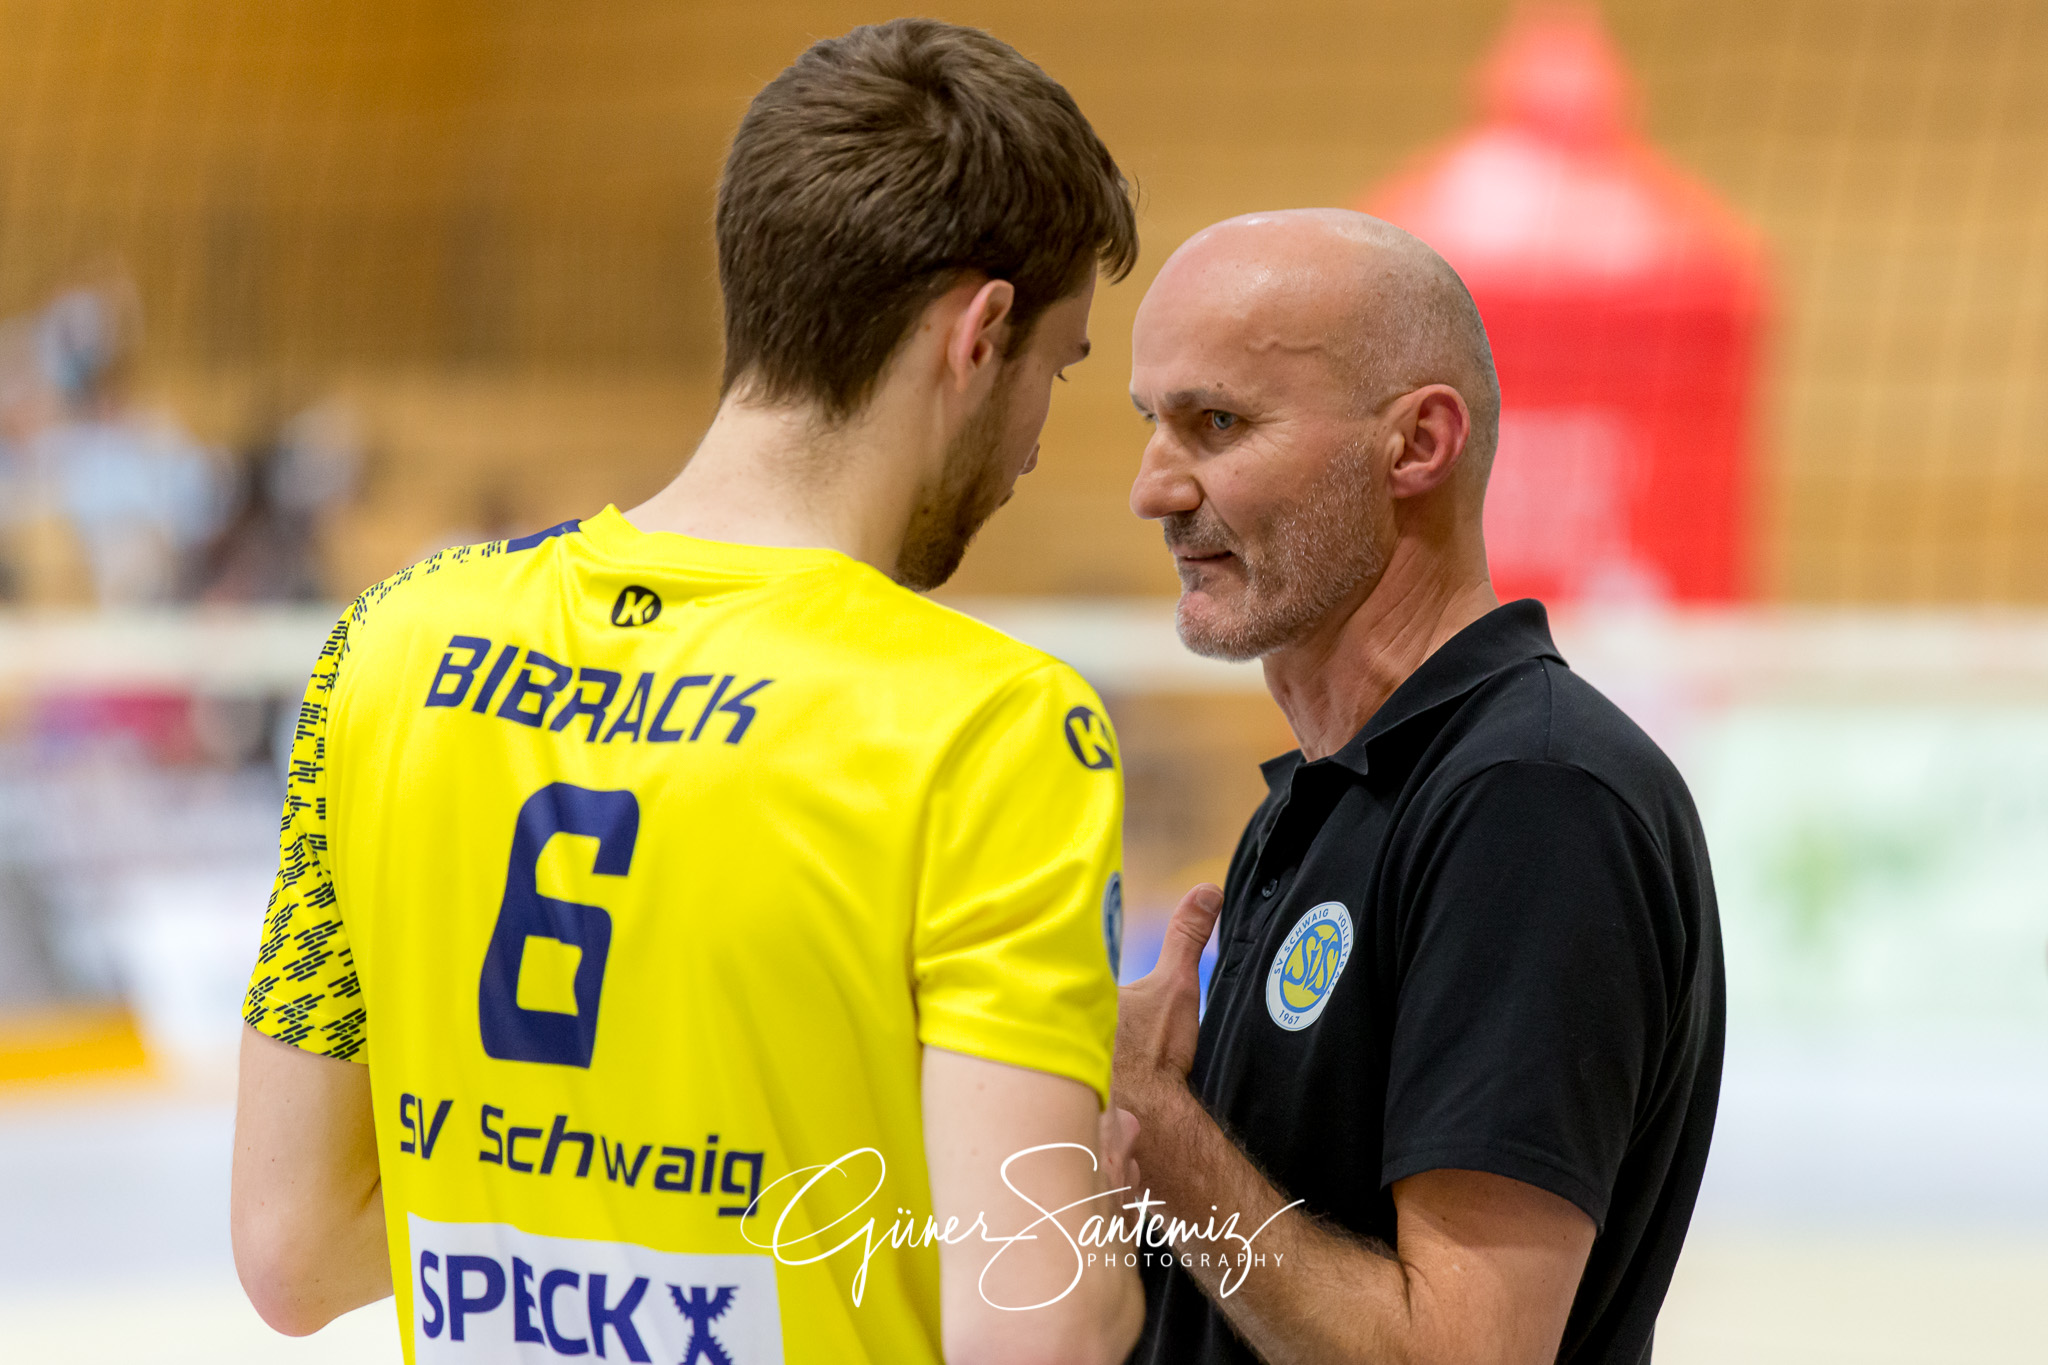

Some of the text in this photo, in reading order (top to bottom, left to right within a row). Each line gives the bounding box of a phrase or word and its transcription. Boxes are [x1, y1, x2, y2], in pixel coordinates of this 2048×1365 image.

[424, 635, 776, 745] BIBRACK
[479, 781, 641, 1069] 6
[1274, 958, 1284, 975] SV
[1284, 908, 1329, 953] SCHWAIG
[1278, 1009, 1300, 1025] 1967
[400, 1093, 765, 1217] SV Schwaig
[420, 1250, 653, 1364] SPECK
